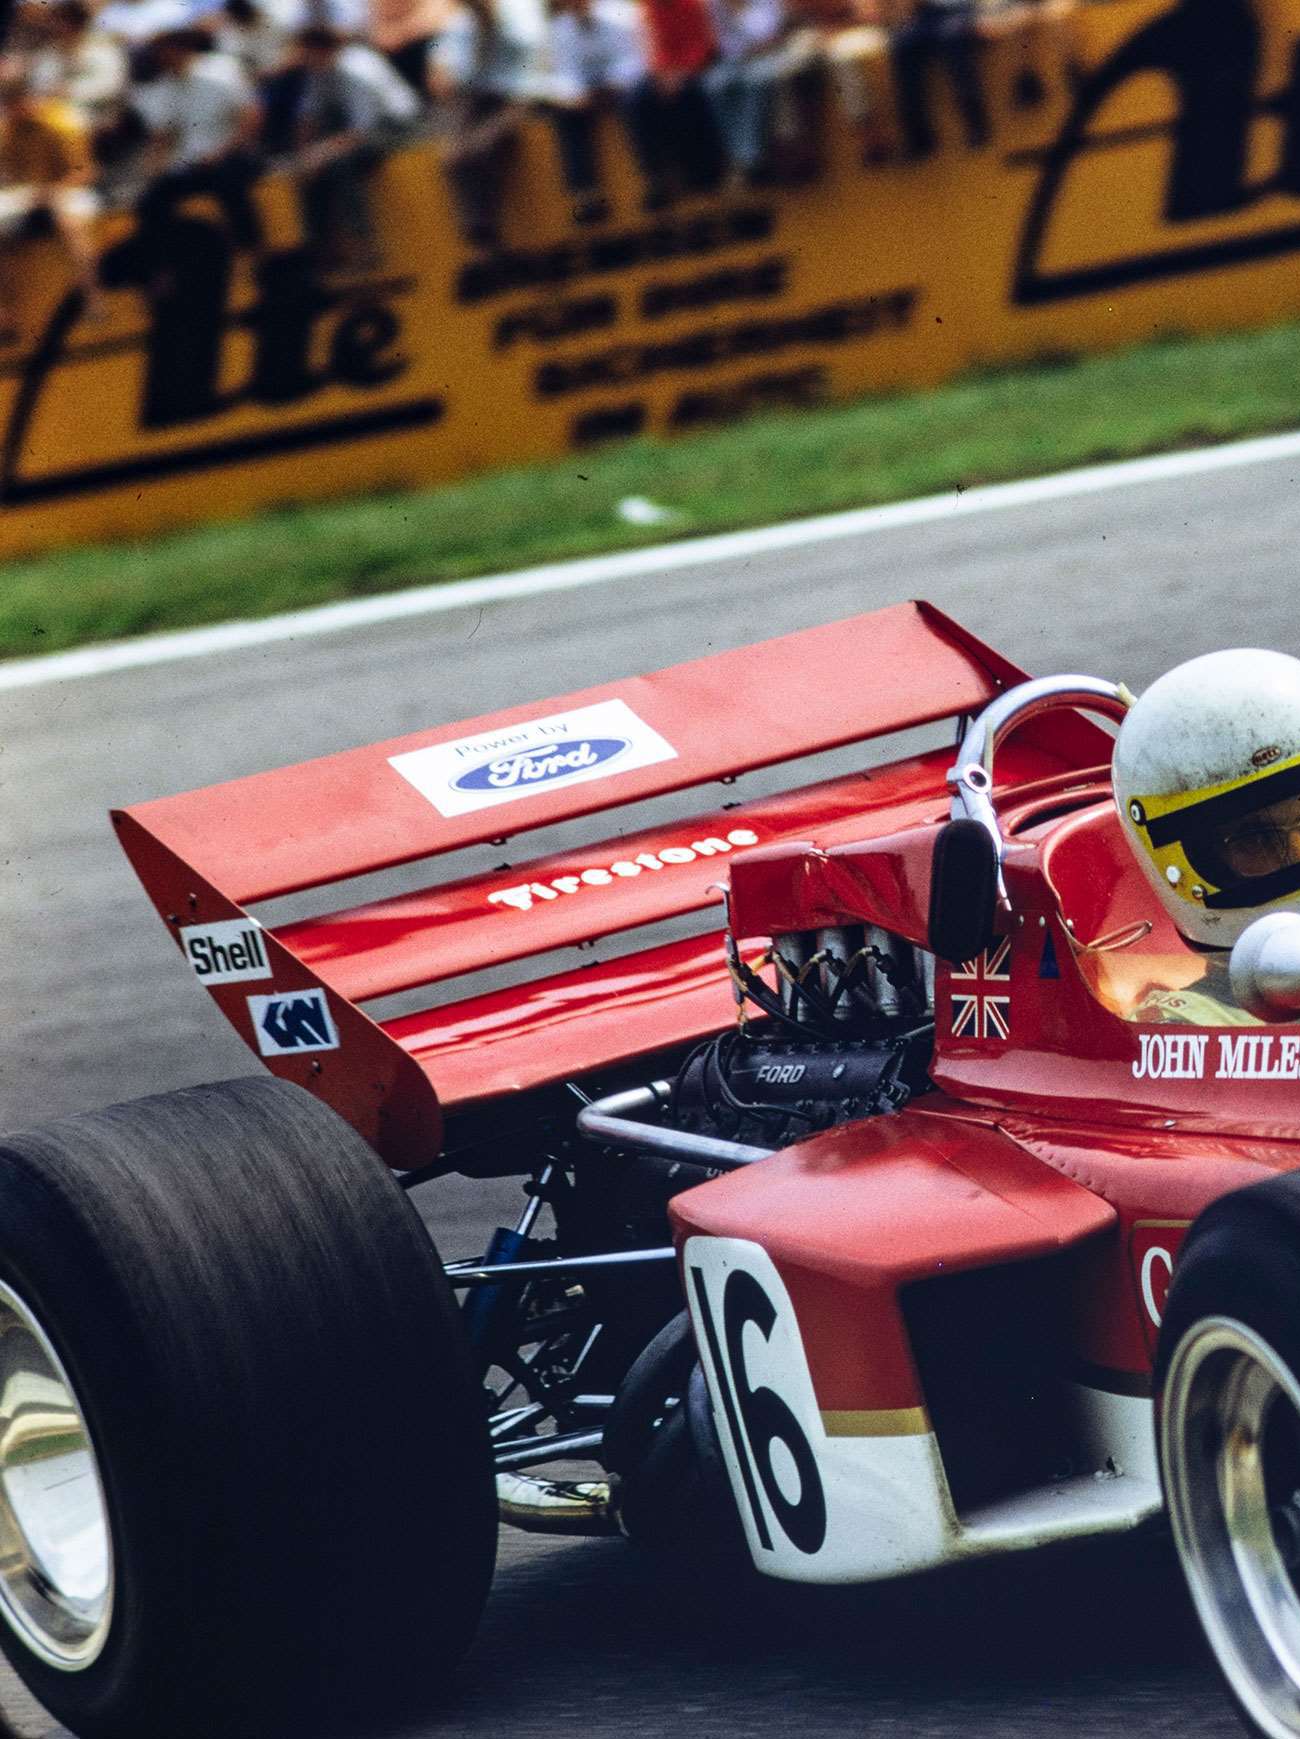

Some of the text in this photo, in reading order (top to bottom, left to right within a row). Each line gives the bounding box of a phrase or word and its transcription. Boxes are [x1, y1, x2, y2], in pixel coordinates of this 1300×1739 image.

[487, 740, 599, 788] Ford
[487, 827, 759, 911] Firestone
[188, 929, 265, 975] Shell
[755, 1064, 806, 1083] FORD
[1131, 1033, 1209, 1079] JOHN
[690, 1266, 827, 1555] 16
